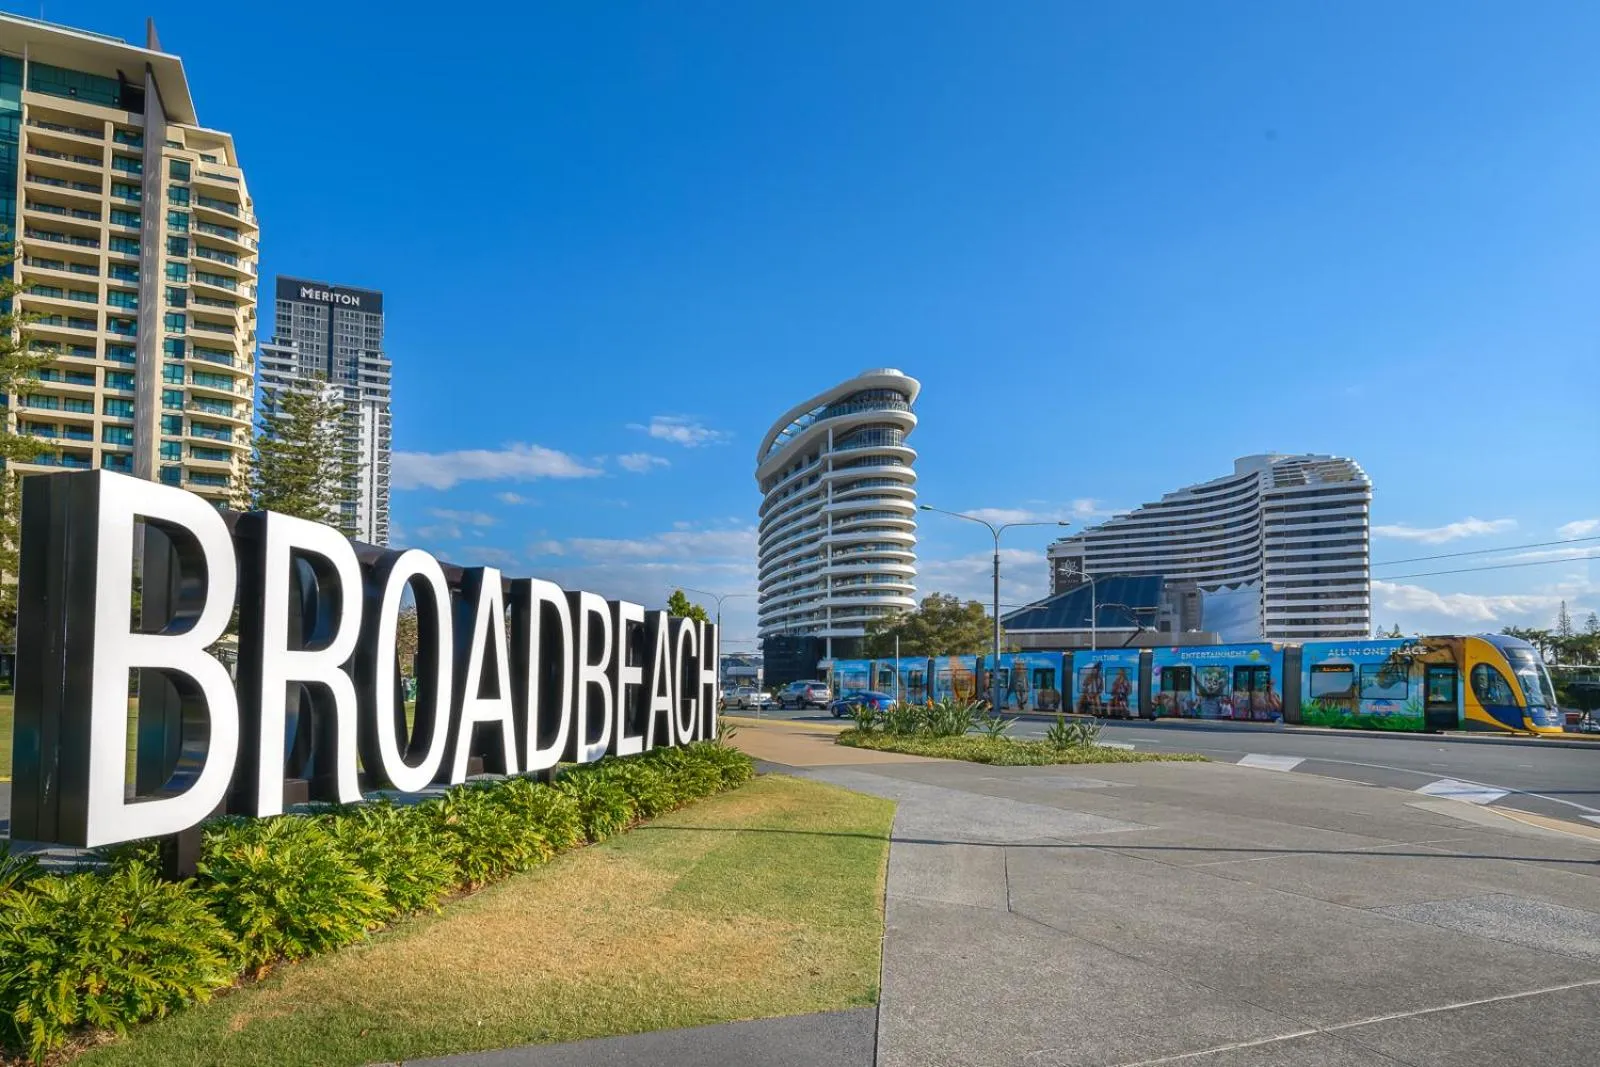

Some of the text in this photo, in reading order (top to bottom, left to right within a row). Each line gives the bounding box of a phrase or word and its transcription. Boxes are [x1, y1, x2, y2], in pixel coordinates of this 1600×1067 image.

[300, 286, 360, 306] MERITON
[86, 469, 719, 848] BROADBEACH
[1327, 646, 1428, 657] ALL IN ONE PLACE
